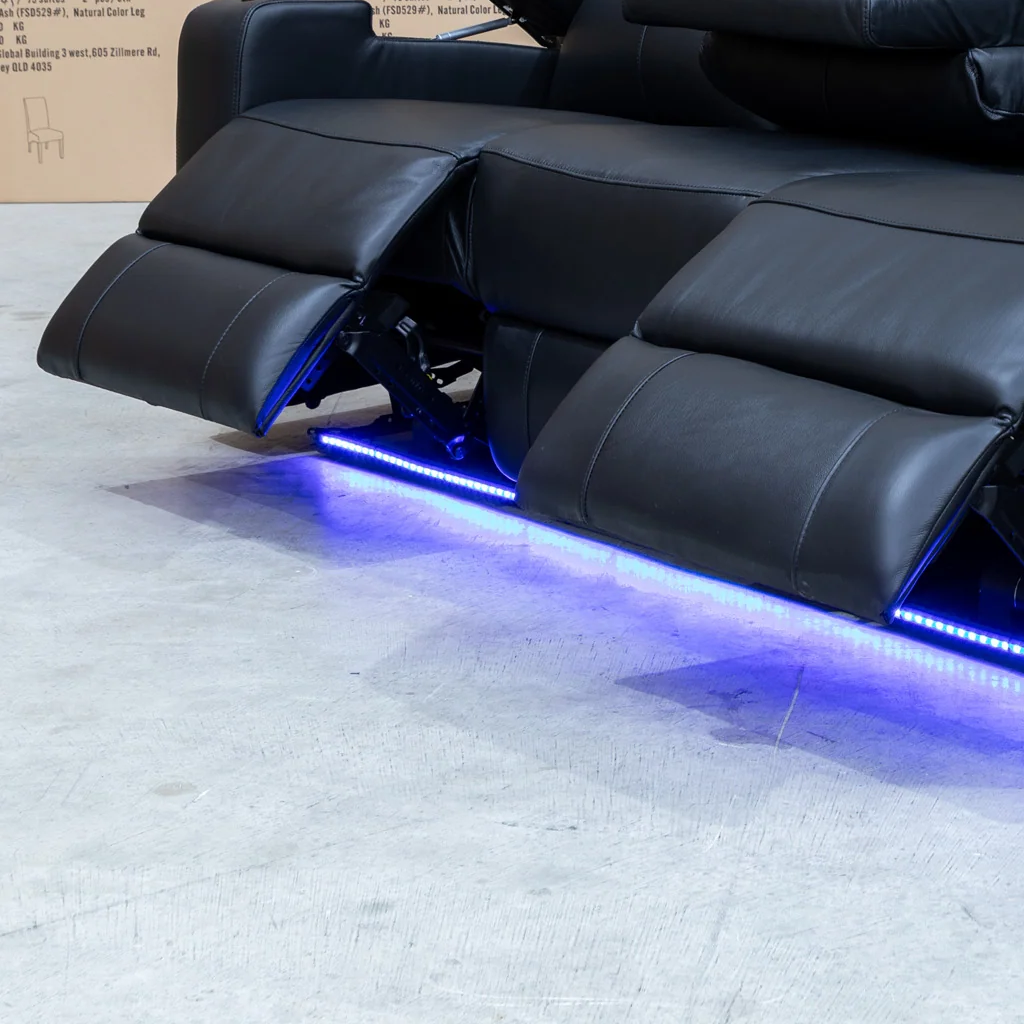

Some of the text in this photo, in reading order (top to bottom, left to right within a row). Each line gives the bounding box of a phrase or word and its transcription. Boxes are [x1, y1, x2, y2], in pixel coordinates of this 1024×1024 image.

[16, 7, 69, 18] (FSD529#),
[73, 8, 104, 18] Natural
[106, 7, 129, 17] Color
[130, 7, 145, 18] Leg
